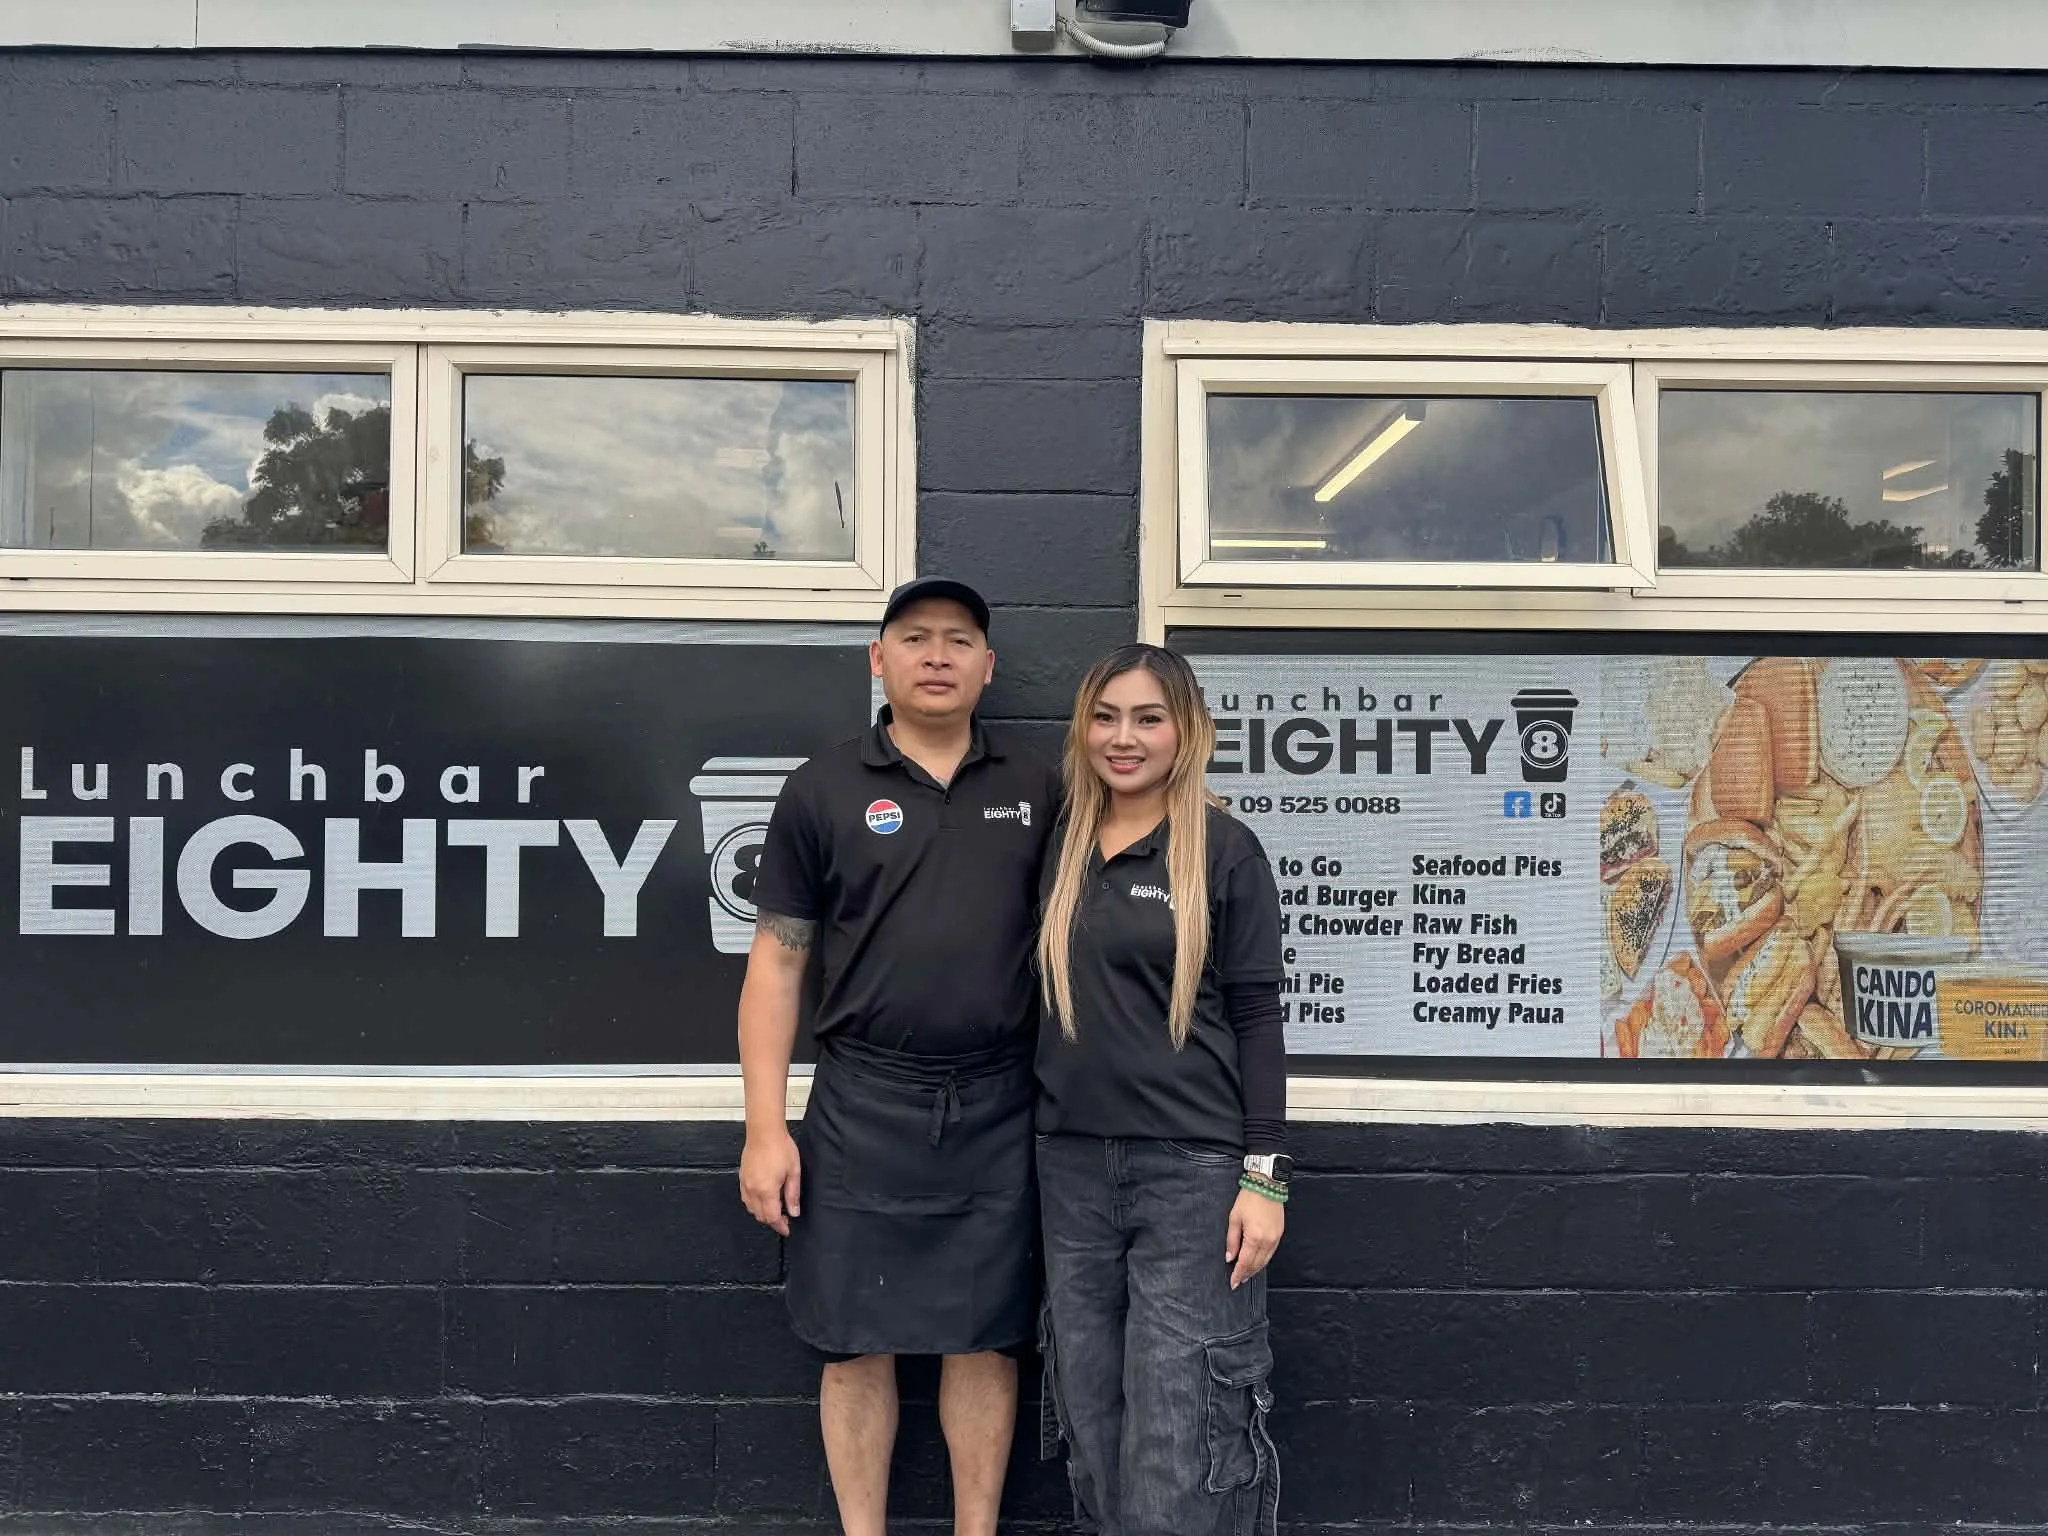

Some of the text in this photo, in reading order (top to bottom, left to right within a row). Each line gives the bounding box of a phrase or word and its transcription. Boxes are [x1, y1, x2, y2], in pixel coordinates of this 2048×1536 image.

[1205, 717, 1505, 775] EIGHTY
[20, 745, 545, 803] Lunchbar
[984, 810, 1020, 819] EIGHTY
[1240, 796, 1272, 813] 09
[1280, 796, 1328, 813] 525
[1336, 796, 1400, 813] 0088
[868, 811, 901, 823] PEPSI
[1279, 856, 1342, 876] to Go
[1412, 854, 1562, 876] Seafood Pies
[19, 814, 678, 939] EIGHTY
[1130, 887, 1170, 902] EIGHTY
[1316, 885, 1397, 912] Burger
[1412, 884, 1466, 905] Kina
[1299, 914, 1403, 936] Chowder
[1412, 913, 1517, 935] Raw Fish
[1412, 942, 1526, 969] Fry Bread
[1308, 972, 1345, 994] Pie
[1413, 972, 1562, 994] Loaded Fries
[1856, 966, 1936, 998] CANDO
[1299, 1002, 1345, 1024] Pies
[1413, 1002, 1564, 1030] Creamy Paua
[1858, 997, 1934, 1039] KINA
